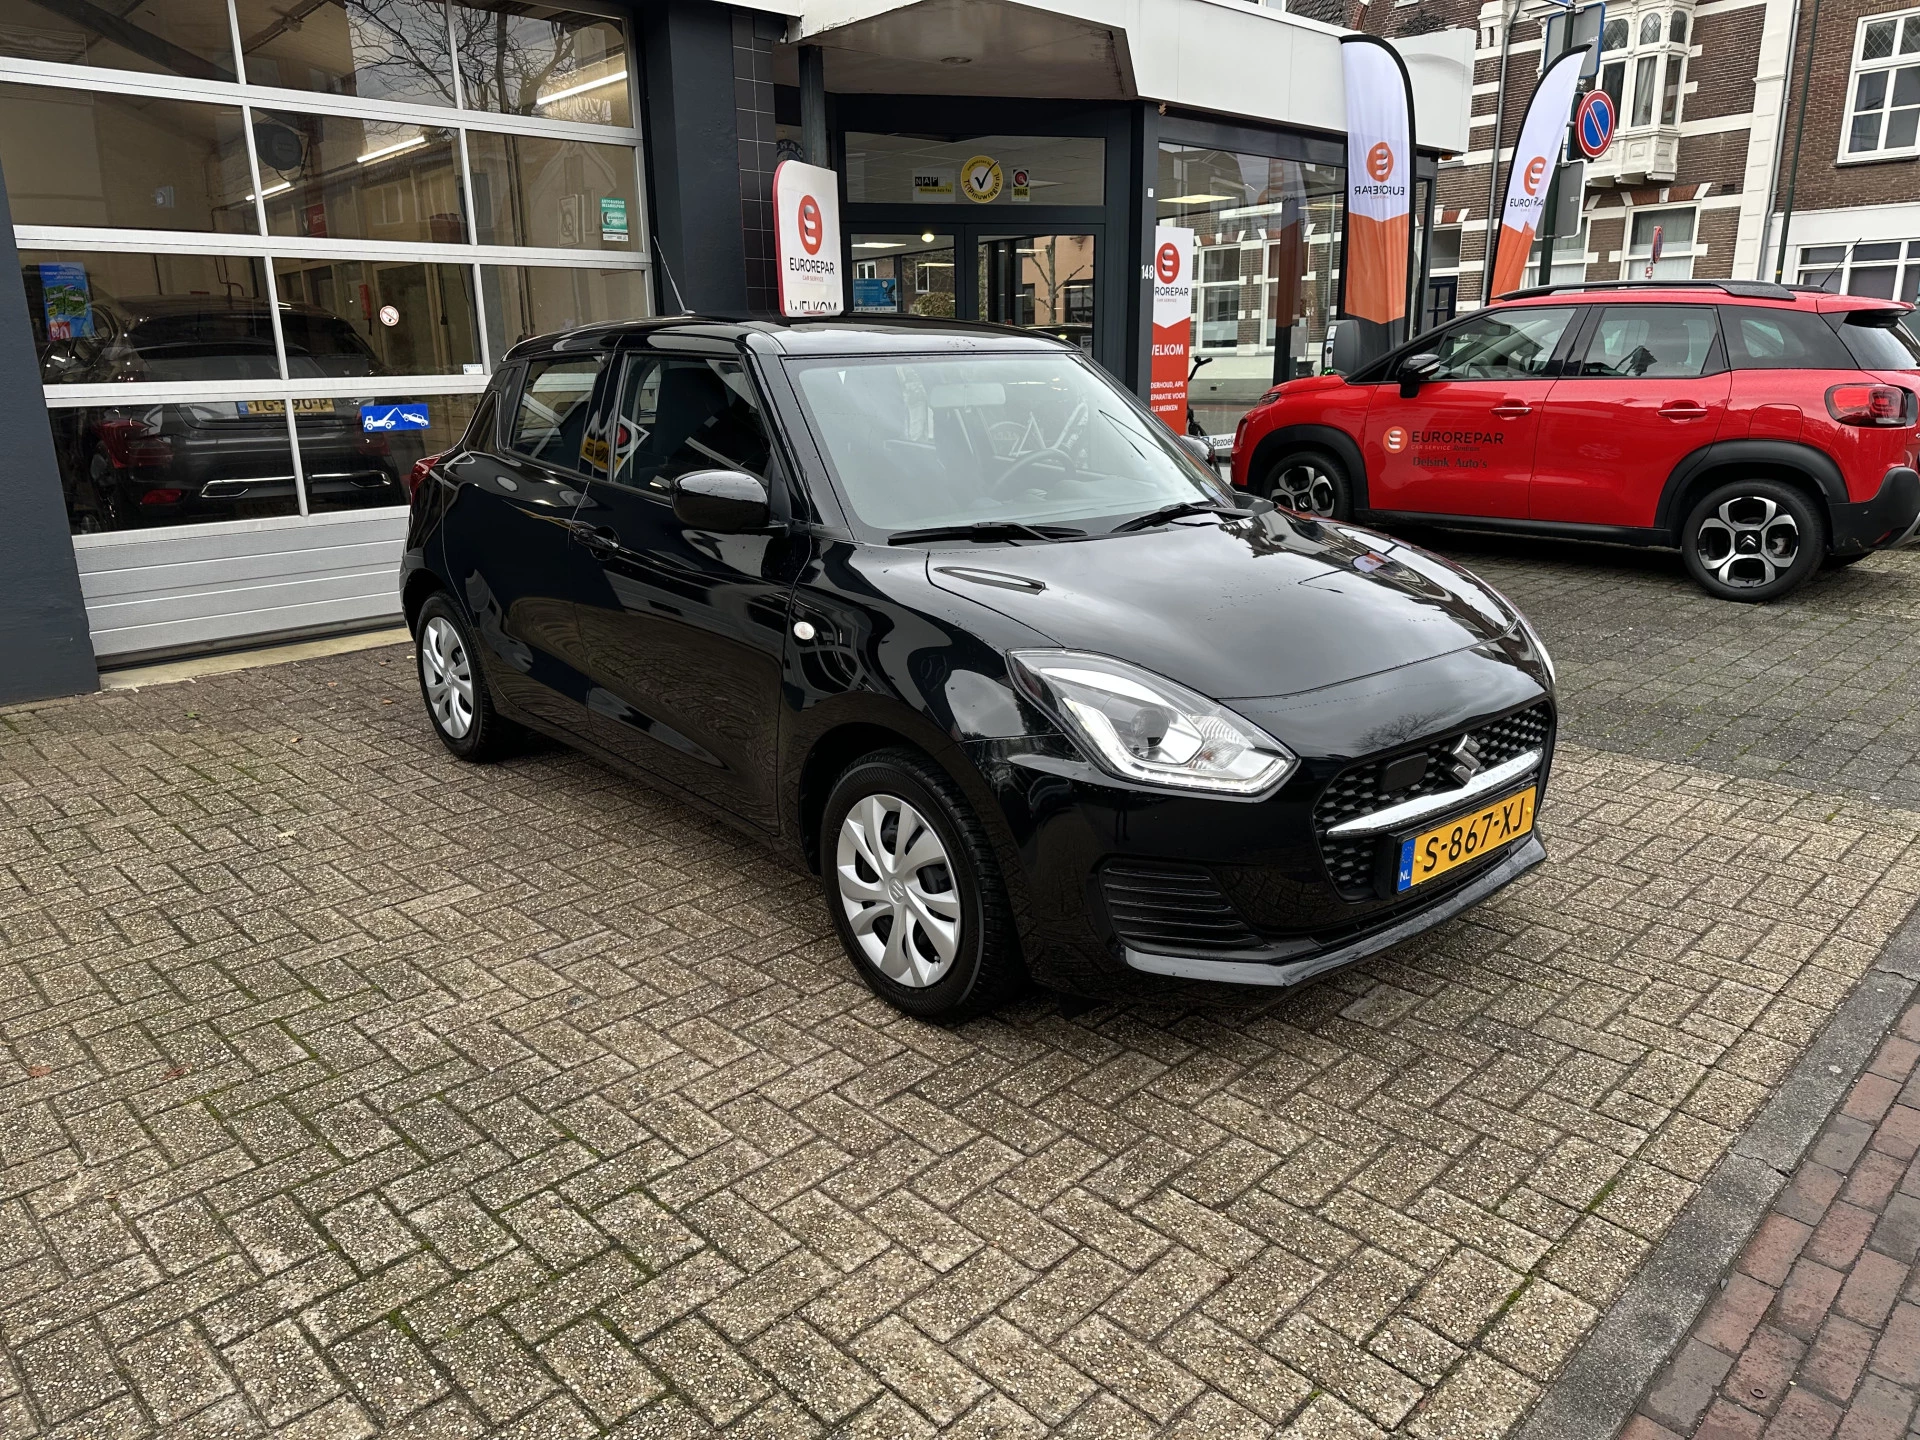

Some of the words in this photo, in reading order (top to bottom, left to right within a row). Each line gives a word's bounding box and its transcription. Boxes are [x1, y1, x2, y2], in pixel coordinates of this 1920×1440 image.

[915, 177, 938, 187] NAP
[789, 257, 835, 275] EUROREPAR
[1141, 265, 1154, 280] 148
[1151, 343, 1184, 356] ELKOM
[1174, 380, 1184, 388] APK
[1159, 404, 1179, 412] MERKEN
[1412, 430, 1505, 444] EUROREPAR
[1455, 458, 1488, 468] Auto's
[1423, 797, 1525, 873] S-867-XJ
[1399, 870, 1411, 882] NL
